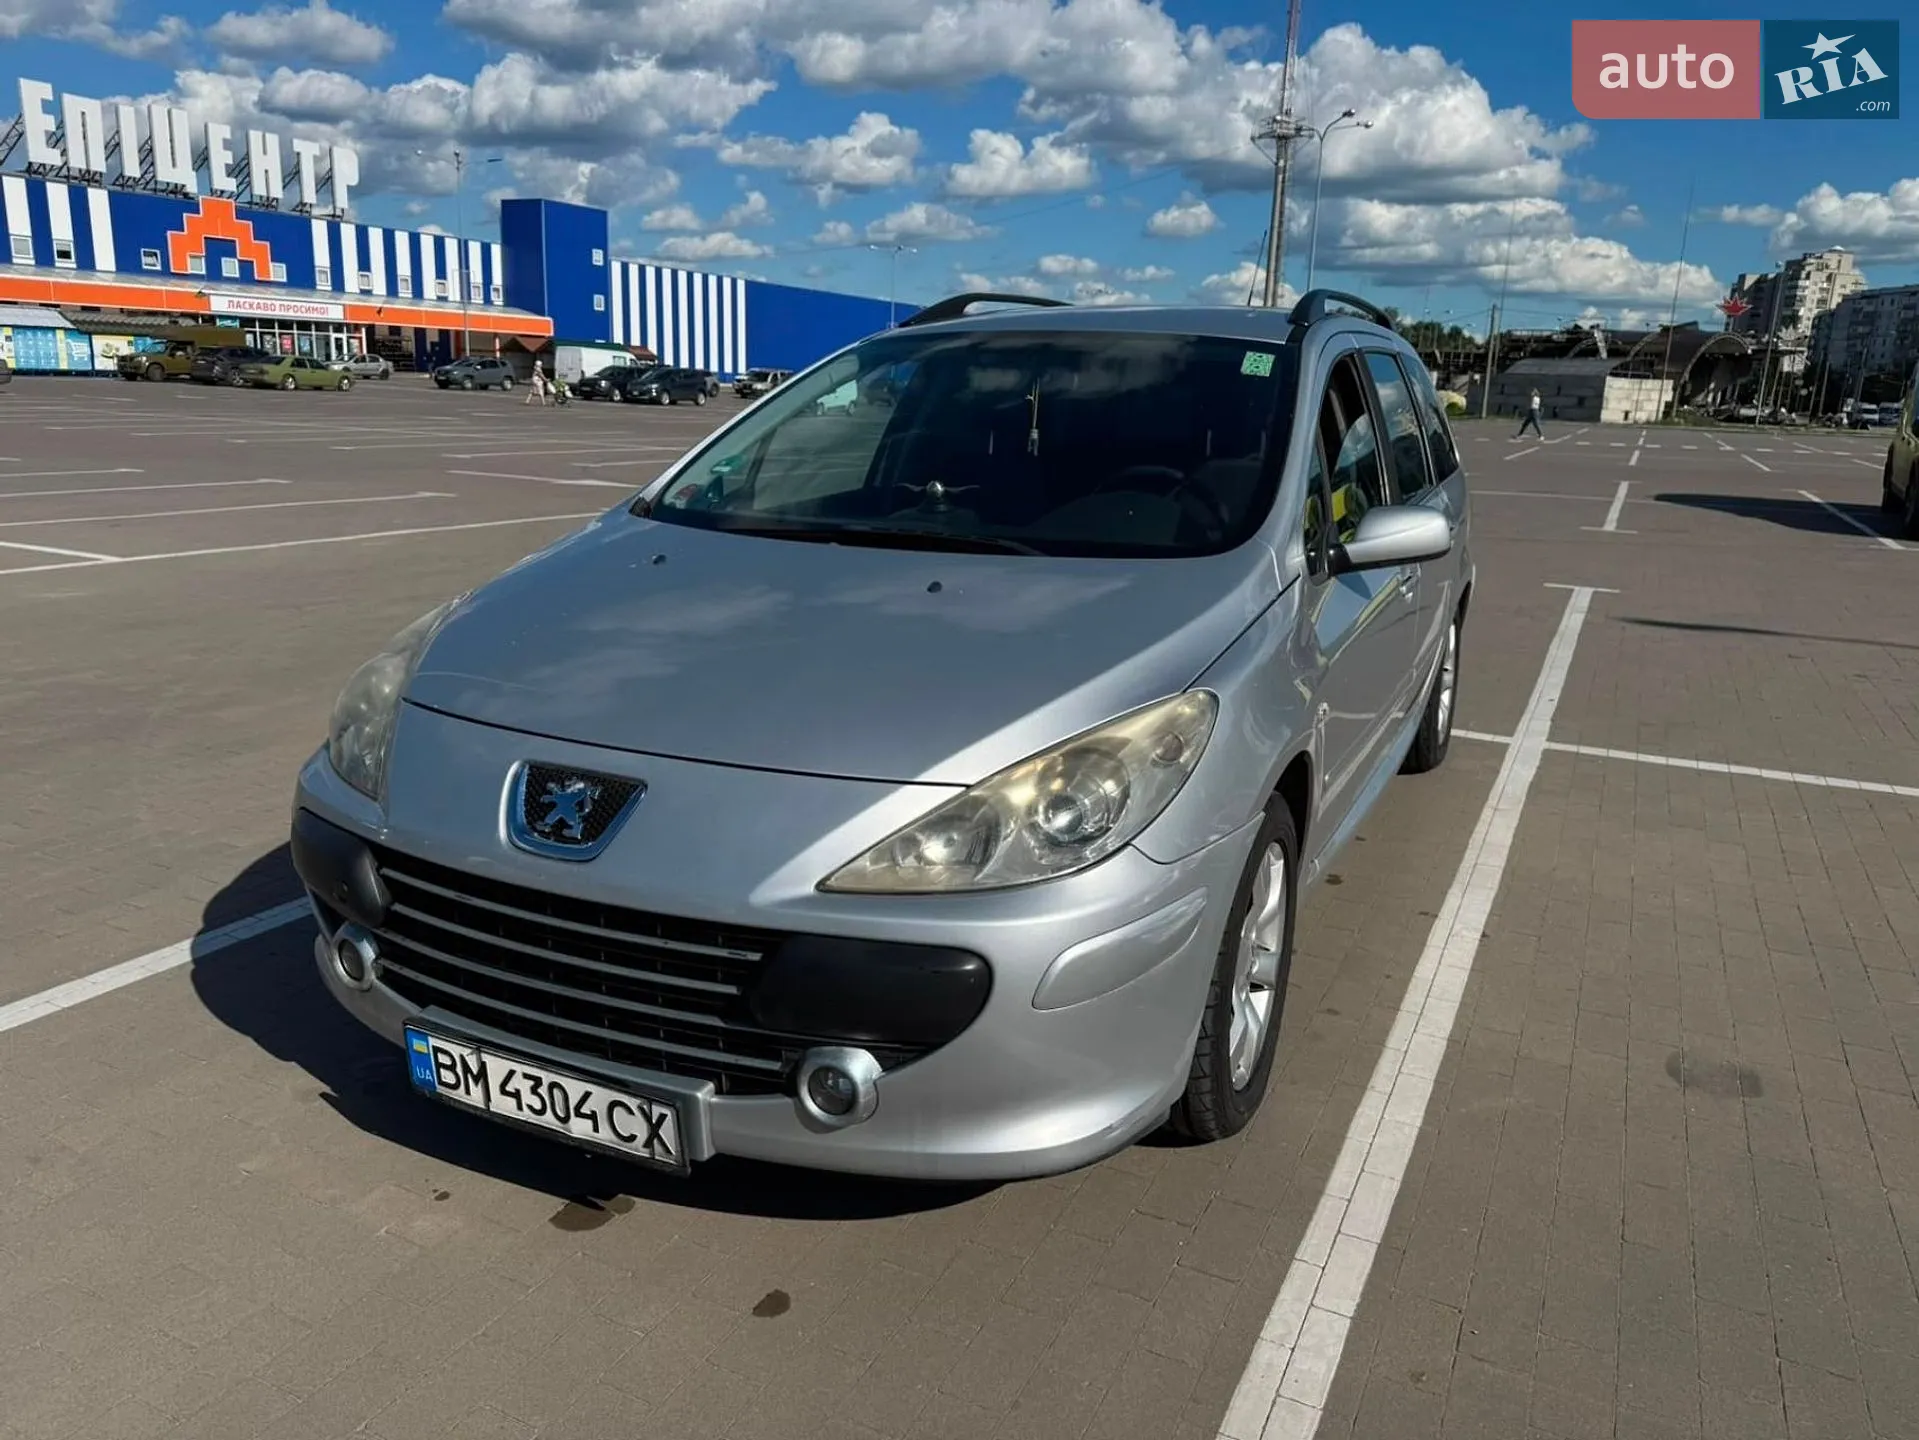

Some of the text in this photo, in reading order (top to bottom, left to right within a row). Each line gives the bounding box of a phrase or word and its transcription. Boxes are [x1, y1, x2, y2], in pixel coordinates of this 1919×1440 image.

[19, 78, 361, 210] ЕПІЦЕНТР
[416, 1066, 433, 1082] UA
[499, 1068, 602, 1134] 4304
[607, 1099, 676, 1155] CX
